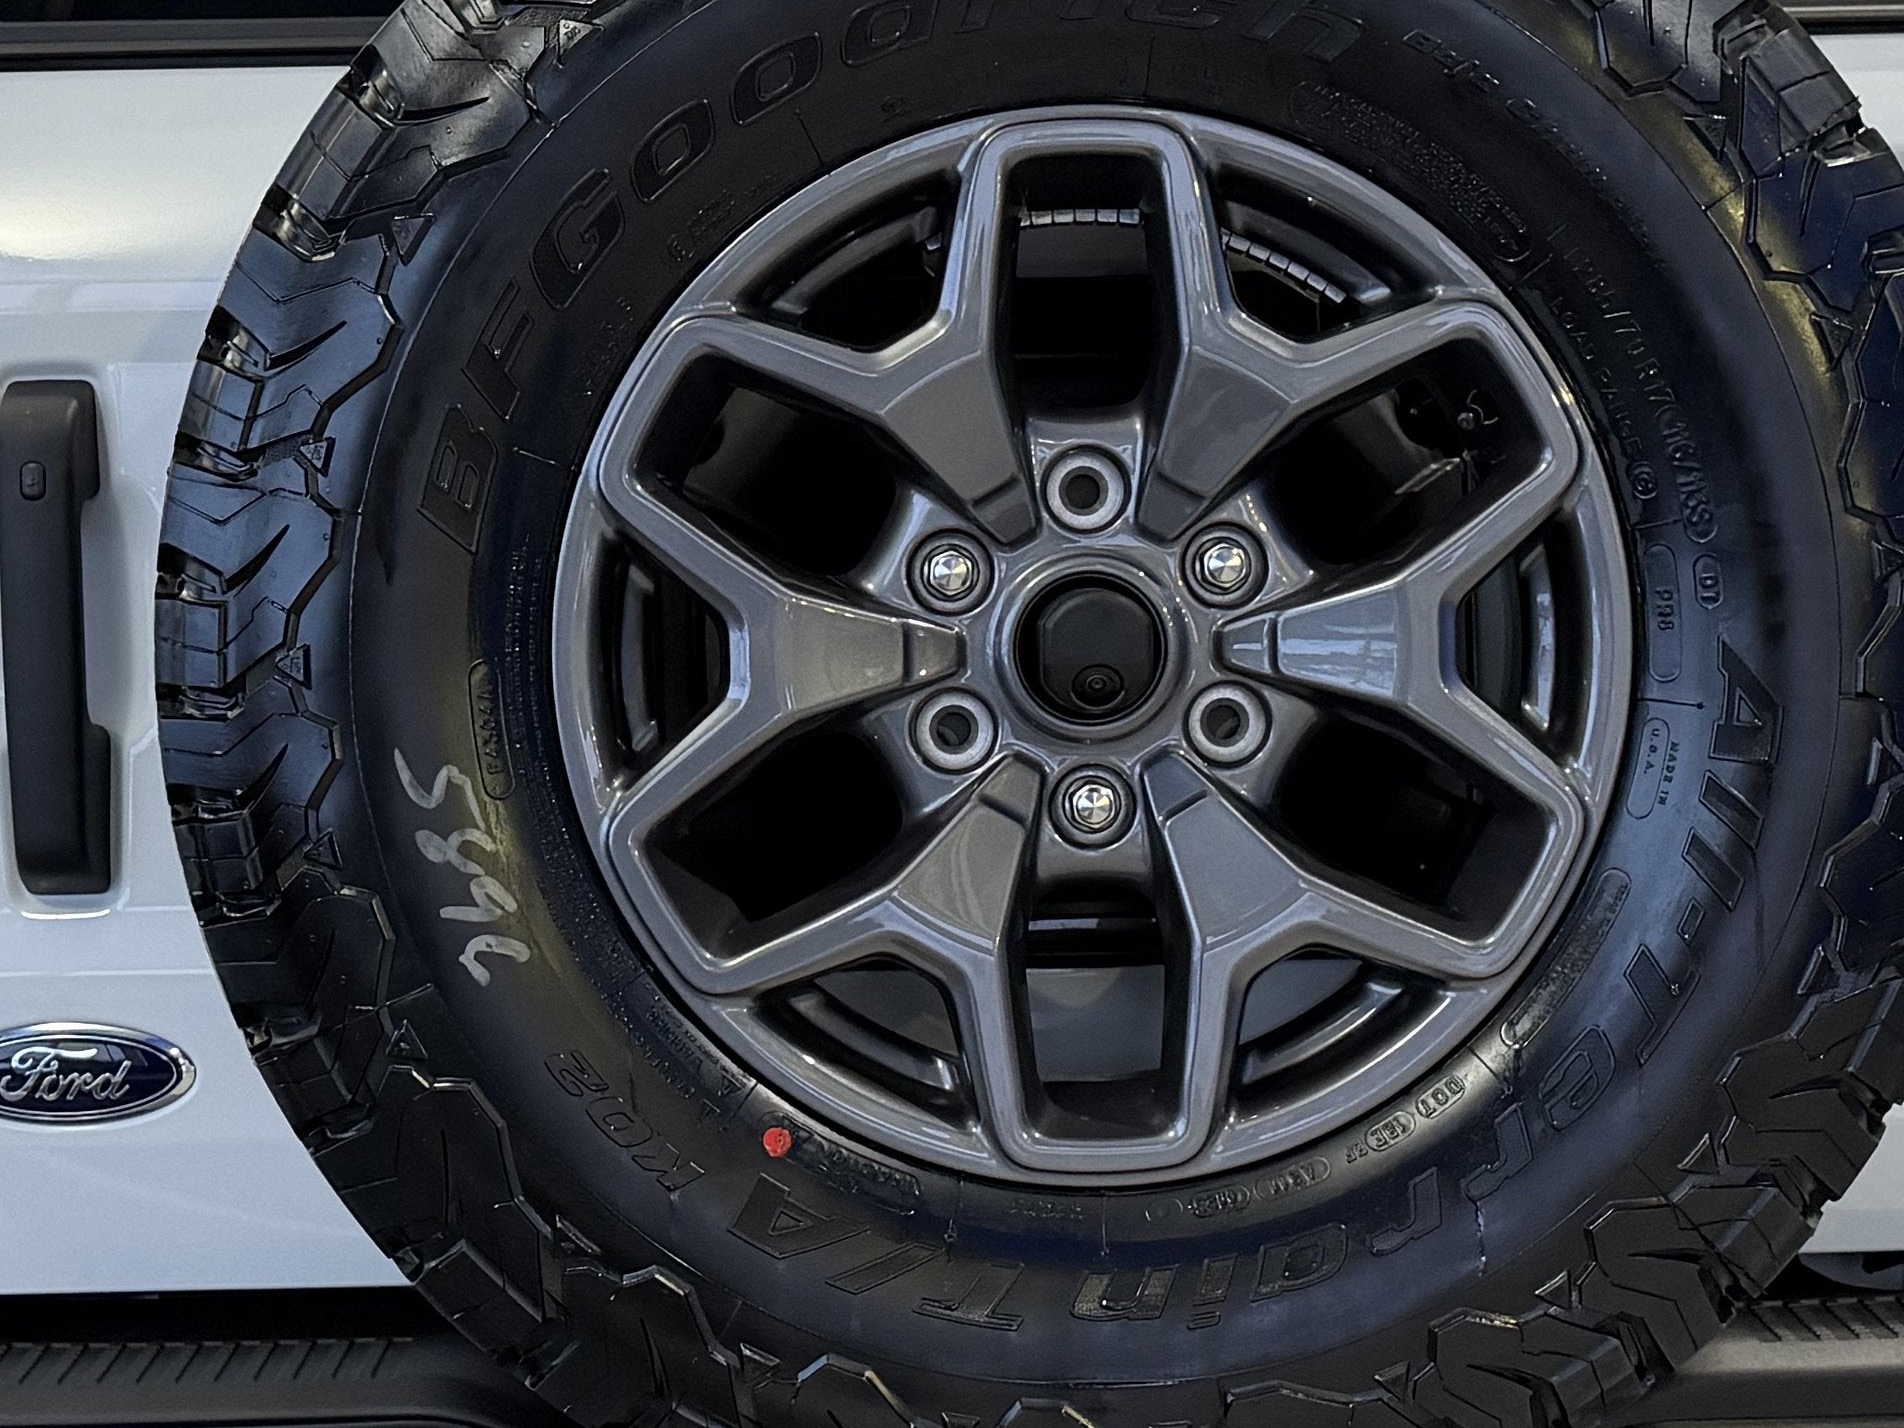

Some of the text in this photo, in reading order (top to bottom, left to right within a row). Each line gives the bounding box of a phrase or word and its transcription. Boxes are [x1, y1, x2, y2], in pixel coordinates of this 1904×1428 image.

[0, 1046, 132, 1101] Ford
[1416, 1074, 1465, 1118] DOT
[723, 1169, 1030, 1335] T/A
